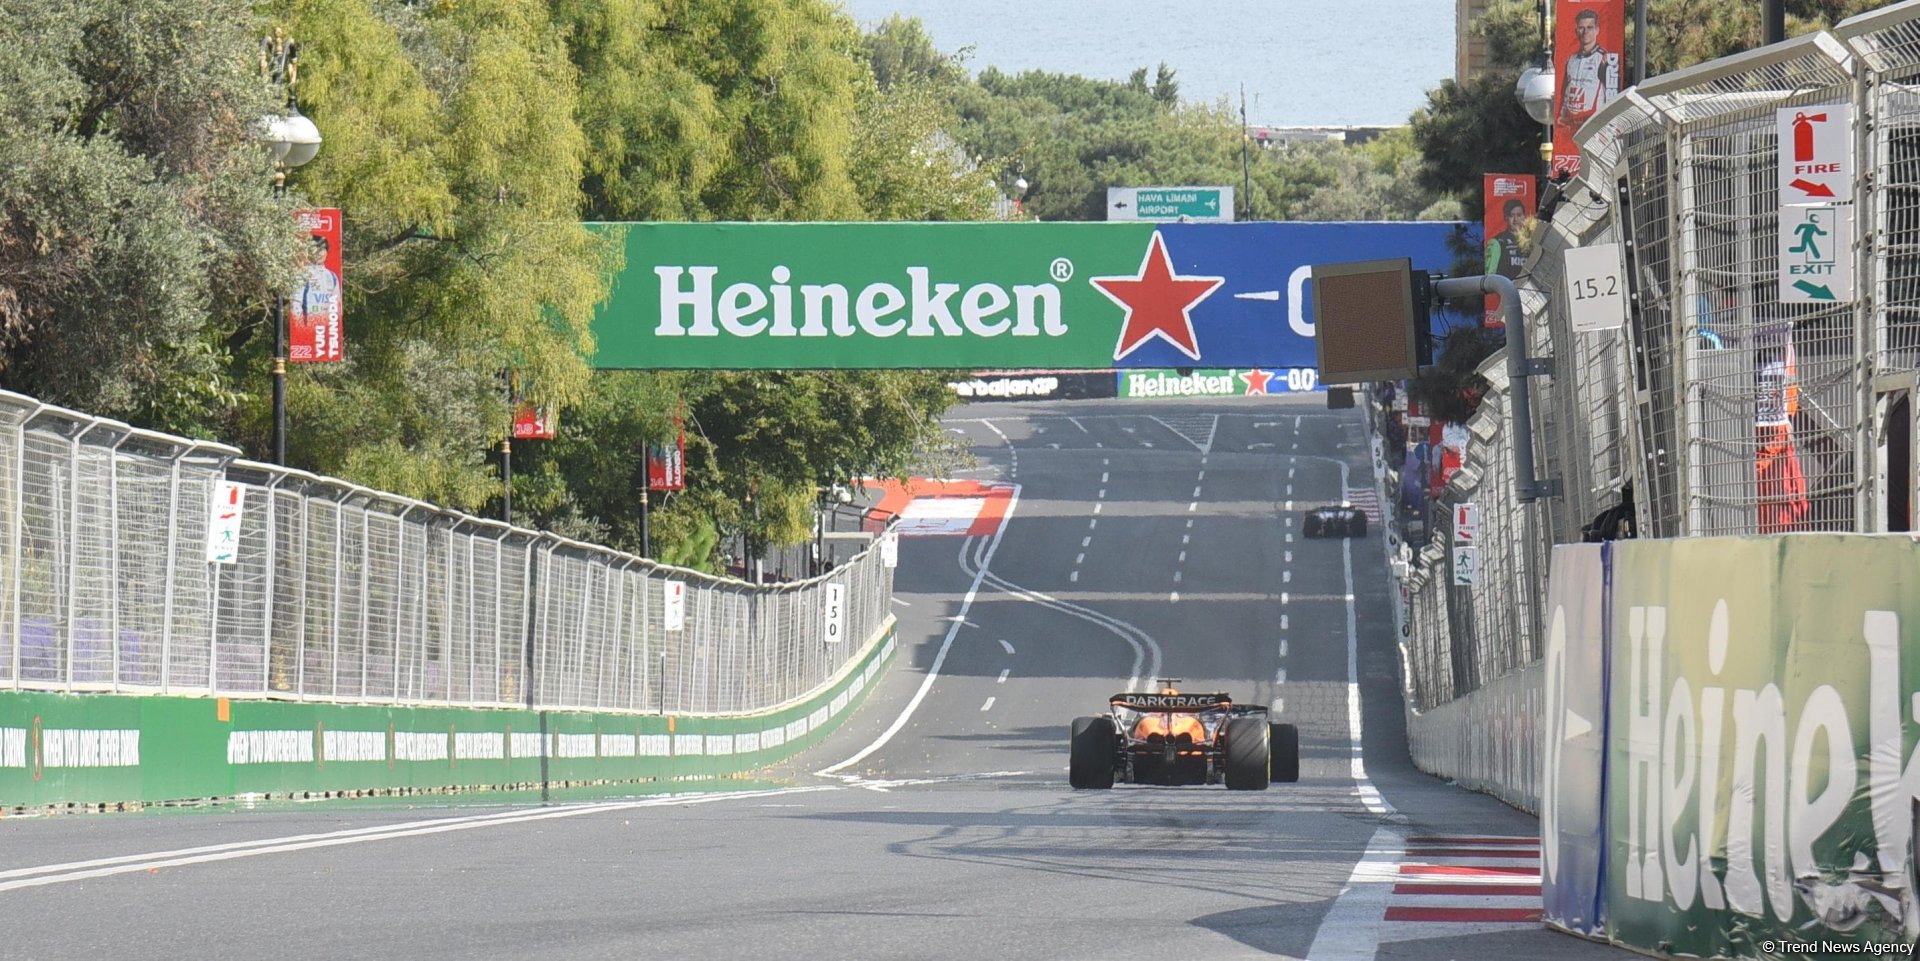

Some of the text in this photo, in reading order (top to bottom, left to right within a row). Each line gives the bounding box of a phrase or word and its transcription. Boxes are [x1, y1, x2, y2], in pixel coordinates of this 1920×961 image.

[1795, 163, 1841, 175] FIRE
[1138, 193, 1163, 202] HAVA
[1139, 204, 1179, 214] AIRPORT
[1789, 264, 1836, 275] EXIT
[1573, 275, 1618, 300] 15.2
[654, 265, 1069, 337] Heineken
[328, 295, 339, 358] TSUNODA
[291, 345, 312, 358] 22
[315, 325, 326, 358] YUKI
[1128, 373, 1234, 397] Heineken
[829, 588, 838, 637] 150
[1126, 695, 1216, 707] DARKTRACE
[64, 729, 79, 768] YOU
